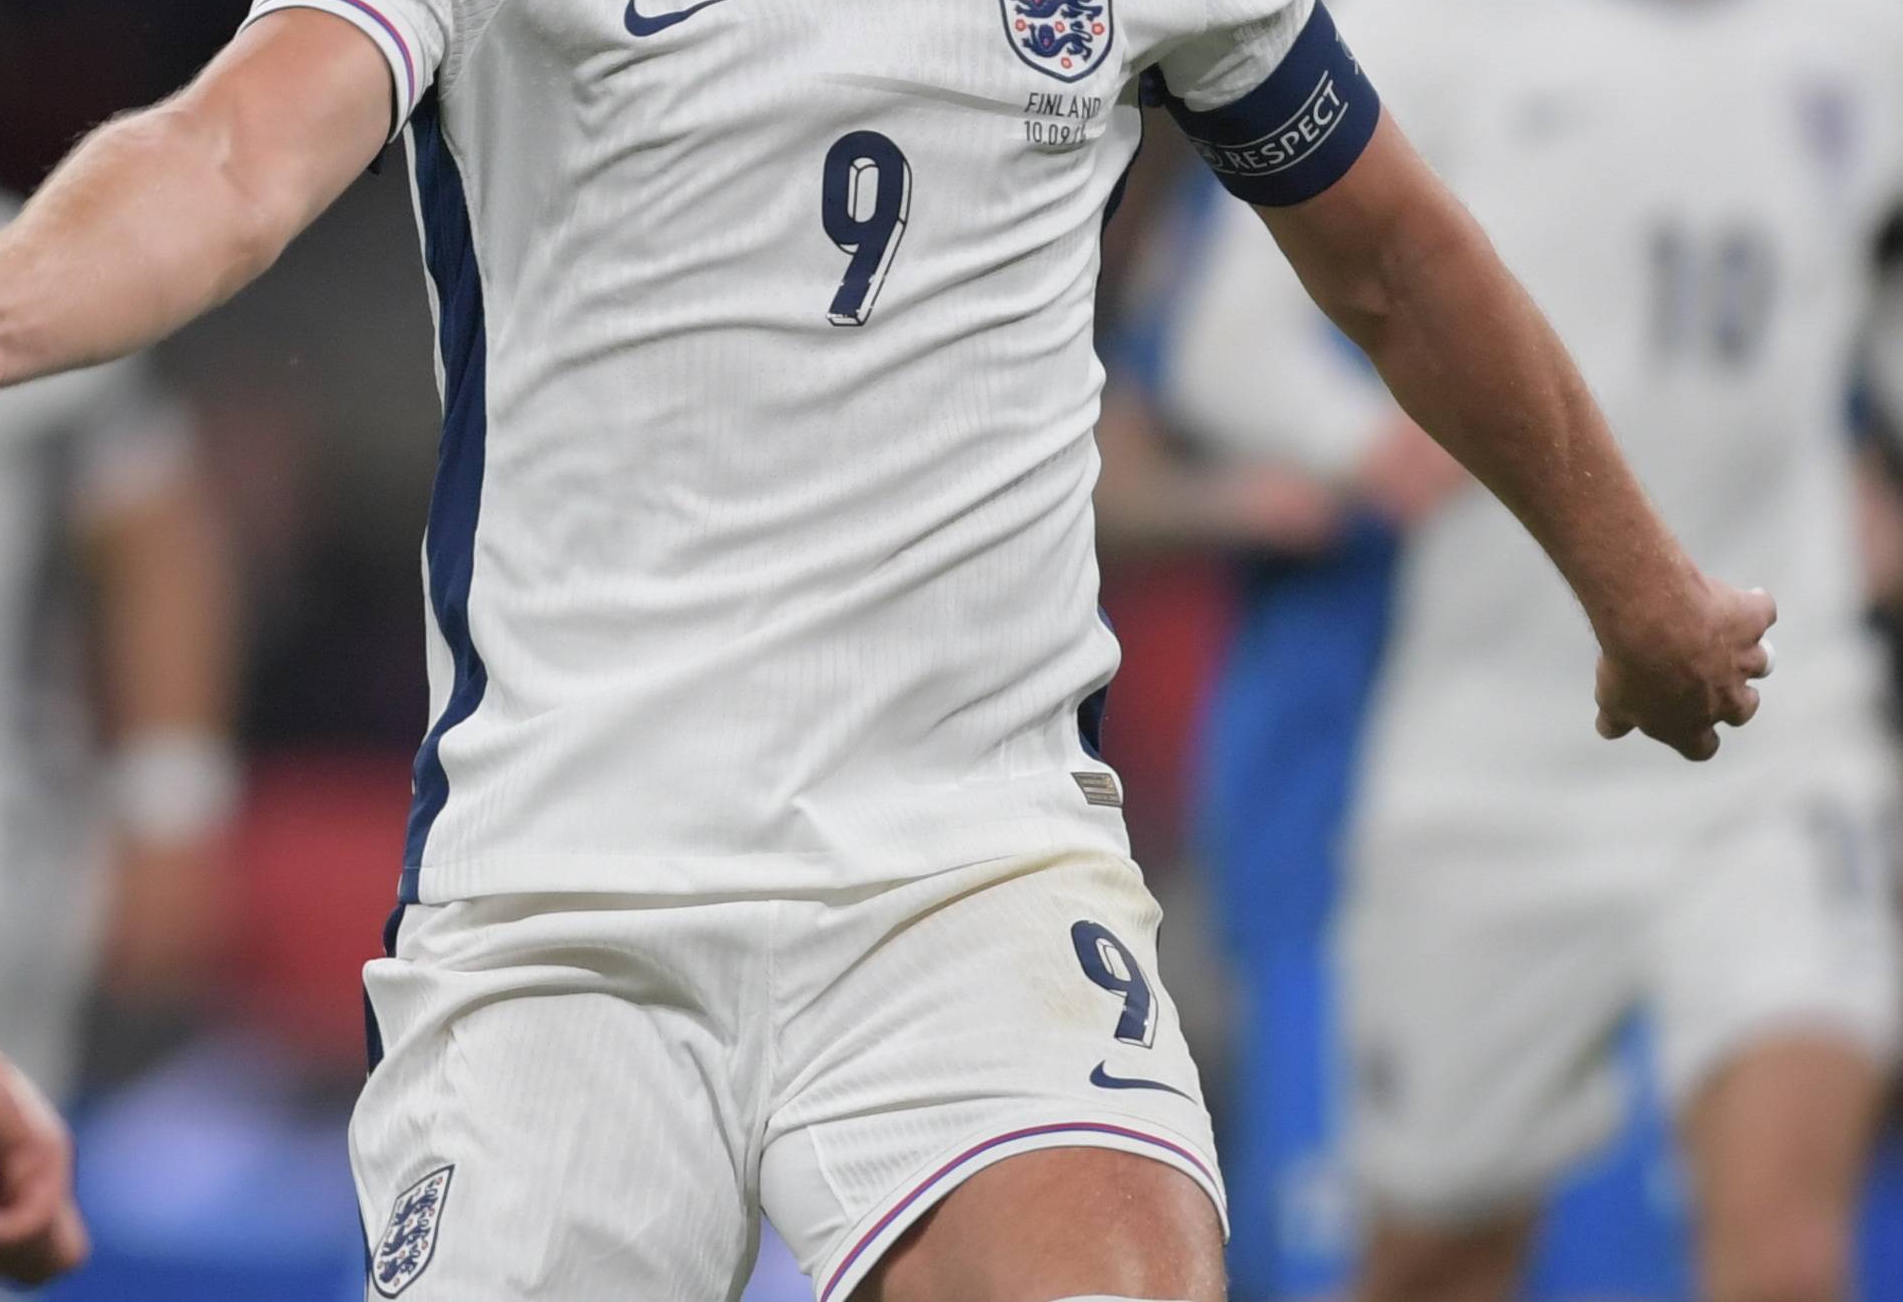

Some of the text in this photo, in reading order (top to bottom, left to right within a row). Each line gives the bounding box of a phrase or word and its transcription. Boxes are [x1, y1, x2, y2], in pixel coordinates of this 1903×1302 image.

[1225, 79, 1340, 169] RESPECT
[821, 129, 912, 327] 9
[1070, 919, 1159, 1049] 9
